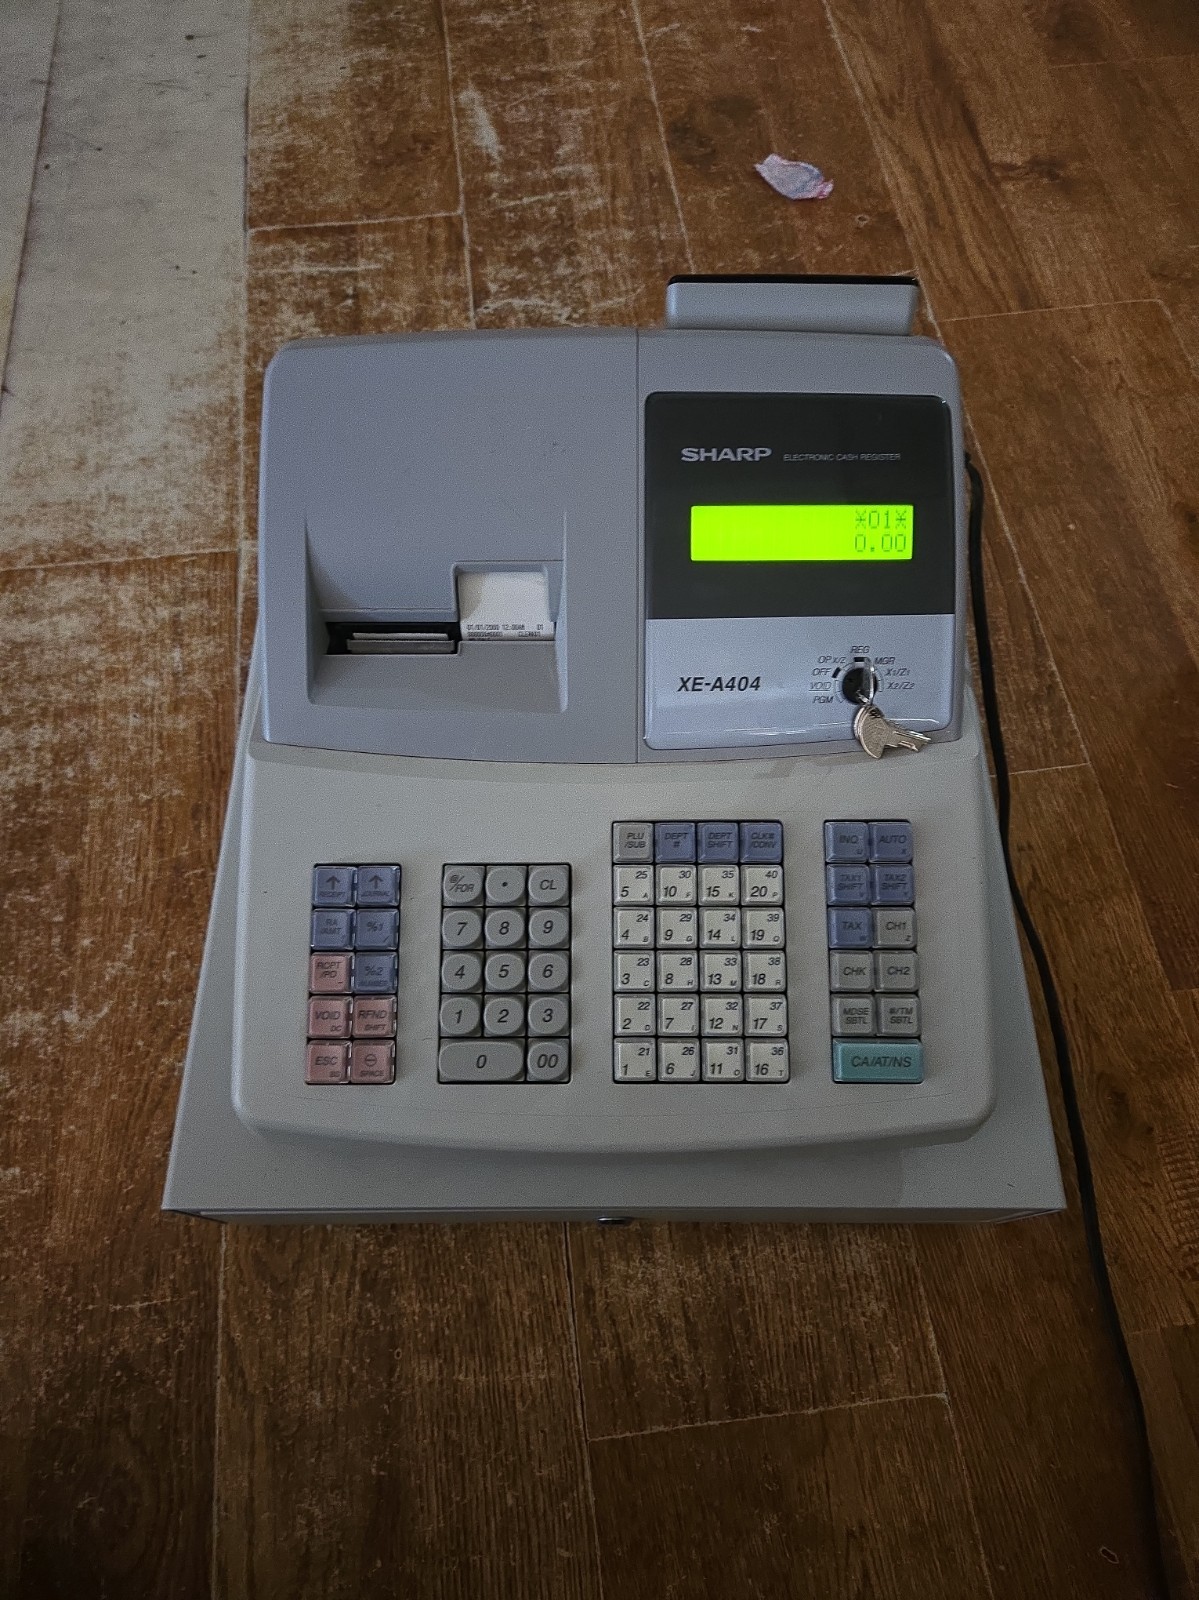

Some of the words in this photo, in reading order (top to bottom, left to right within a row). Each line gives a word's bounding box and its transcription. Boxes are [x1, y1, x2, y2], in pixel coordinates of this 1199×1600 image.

[680, 447, 772, 462] SHARP
[783, 453, 834, 462] ELECTRONIC
[836, 453, 858, 461] CASH
[859, 453, 901, 461] REGISTER
[854, 533, 907, 553] 0.00
[850, 645, 870, 653] REG
[818, 655, 833, 664] OP
[875, 657, 896, 665] MGR
[812, 668, 832, 676] OFF
[677, 676, 762, 692] XE-A404
[810, 682, 832, 690] VOID
[813, 695, 834, 703] PGM
[626, 832, 645, 840] PLU
[664, 832, 688, 840] DEPT
[708, 832, 733, 840] DEPT
[879, 835, 907, 844] AUTO
[635, 870, 648, 879] 25
[678, 870, 691, 879] 30
[721, 870, 735, 879] 35
[765, 870, 778, 879] 40
[539, 879, 557, 891] CL
[838, 883, 865, 891] SHIFT
[620, 886, 630, 897] 5
[663, 886, 677, 897] 10
[706, 886, 720, 897] 15
[750, 886, 768, 897] 20
[636, 914, 649, 922] 24
[679, 914, 692, 922] 29
[723, 914, 736, 922] 34
[766, 914, 780, 922] 39
[457, 921, 468, 936] 7
[499, 921, 510, 935] 8
[542, 920, 553, 934] 9
[842, 921, 862, 930] TAX
[885, 921, 906, 930] CH1
[621, 929, 630, 941] 4
[664, 929, 673, 941] 9
[707, 929, 721, 941] 14
[750, 929, 765, 941] 19
[317, 961, 342, 970] RCPT
[636, 958, 650, 967] 23
[679, 957, 692, 966] 28
[724, 957, 737, 966] 33
[768, 957, 781, 966] 38
[454, 965, 466, 979] 4
[498, 964, 510, 978] 5
[542, 964, 553, 978] 6
[843, 966, 867, 976] CHK
[887, 966, 910, 975] CH2
[621, 973, 630, 985] 3
[665, 973, 674, 985] 8
[708, 973, 722, 985] 13
[752, 973, 766, 985] 18
[637, 1002, 650, 1010] 22
[680, 1002, 694, 1010] 27
[725, 1002, 739, 1010] 32
[769, 1002, 783, 1010] 37
[314, 1010, 340, 1021] VOID
[357, 1009, 388, 1020] RFND
[455, 1009, 463, 1024] 1
[497, 1009, 510, 1023] 2
[542, 1008, 553, 1023] 3
[622, 1018, 632, 1030] 2
[665, 1018, 674, 1030] 7
[709, 1018, 724, 1029] 12
[753, 1018, 768, 1030] 17
[638, 1047, 650, 1056] 21
[681, 1047, 695, 1056] 26
[726, 1047, 739, 1055] 31
[771, 1047, 784, 1055] 36
[314, 1055, 338, 1066] ESC
[476, 1054, 487, 1069] 0
[537, 1054, 559, 1069] 00
[851, 1056, 912, 1068] CA/AT/NS
[622, 1064, 629, 1076] 1
[666, 1063, 675, 1075] 6
[710, 1063, 723, 1075] 11
[754, 1064, 769, 1075] 16
